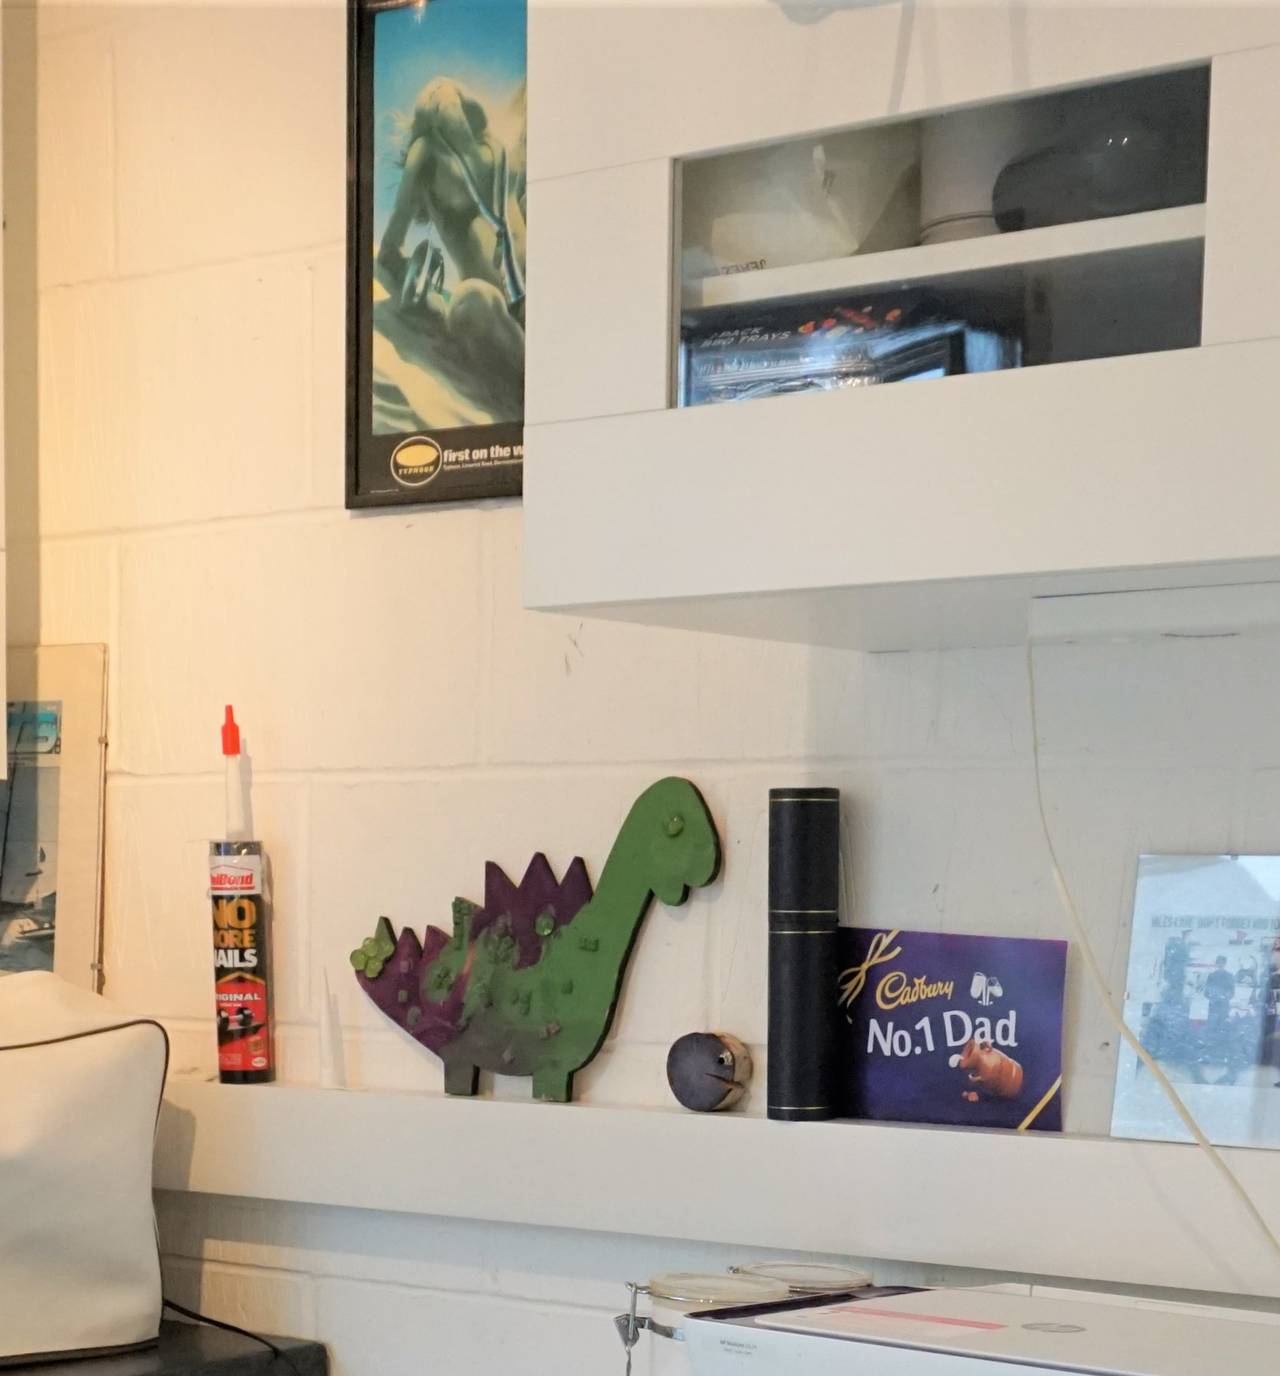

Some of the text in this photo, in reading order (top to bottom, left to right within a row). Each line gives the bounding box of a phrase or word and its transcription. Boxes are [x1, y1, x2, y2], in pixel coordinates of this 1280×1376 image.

[738, 331, 791, 344] TRAYS
[443, 449, 469, 462] first
[472, 449, 487, 459] on
[490, 446, 510, 457] the
[214, 929, 256, 948] ORE
[215, 949, 258, 968] AILS
[875, 970, 955, 1011] Cadbury
[866, 1009, 1019, 1058] No.1 Dad
